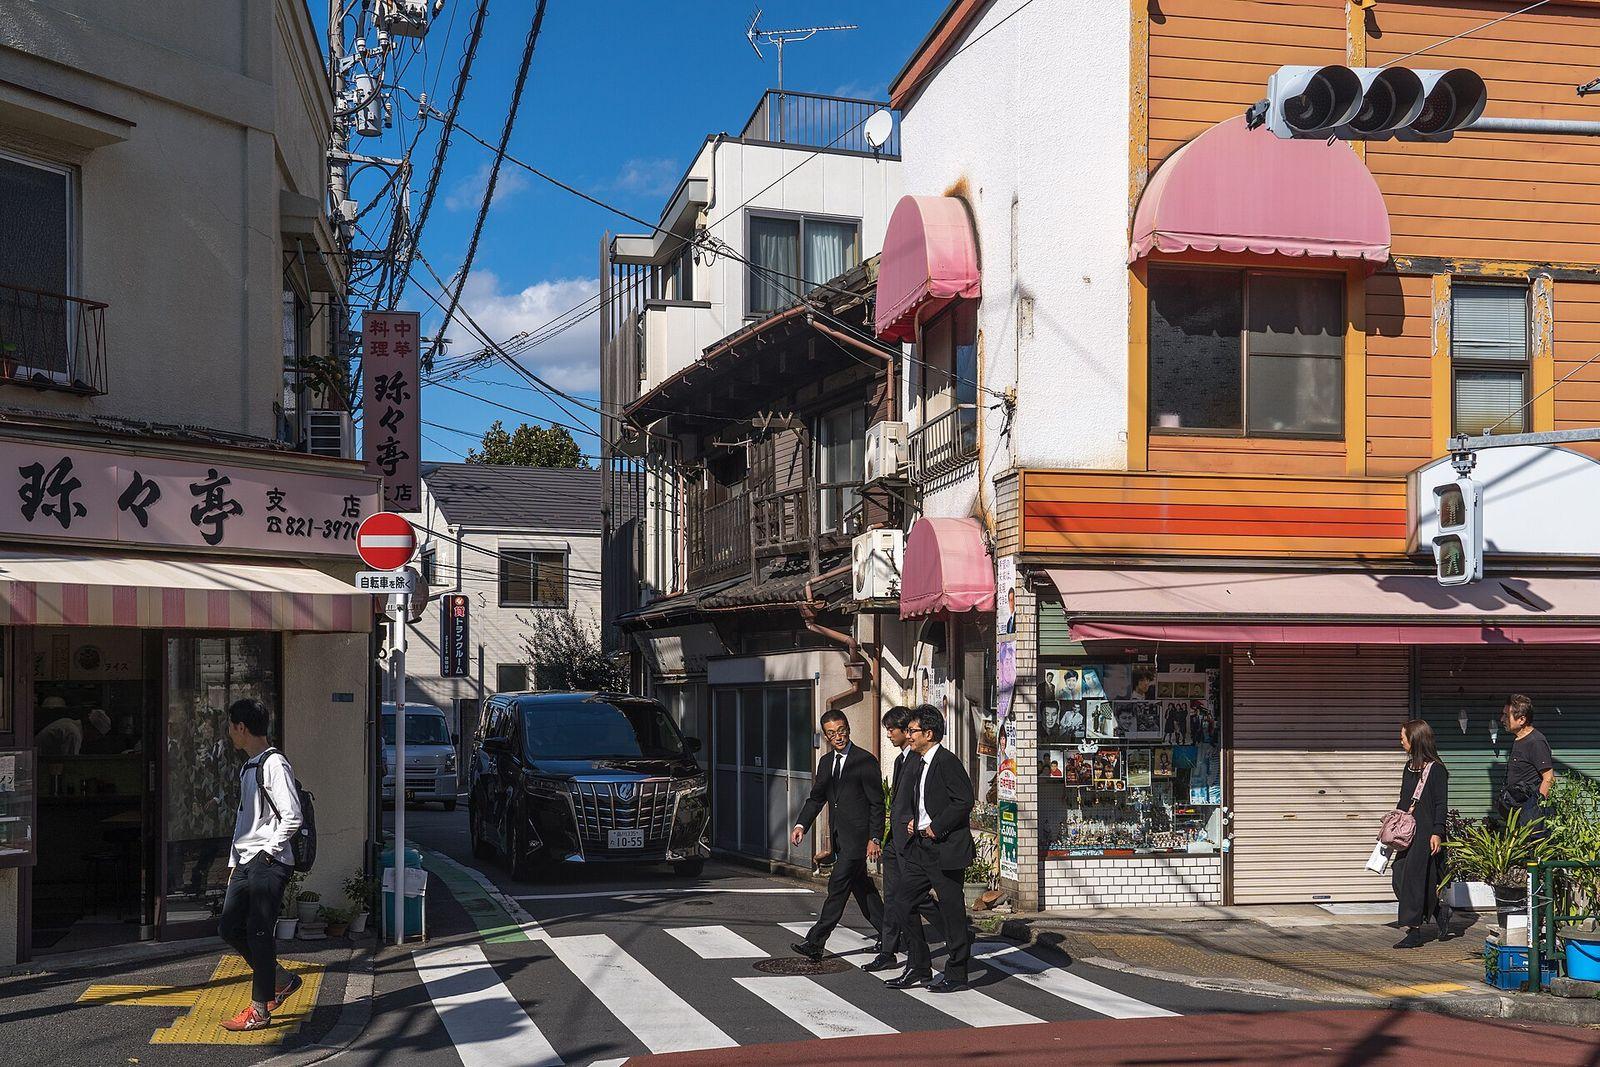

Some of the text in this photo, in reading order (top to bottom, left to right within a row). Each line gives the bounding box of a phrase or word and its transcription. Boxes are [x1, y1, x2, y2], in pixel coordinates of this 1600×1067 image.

[369, 320, 390, 357] 料理
[394, 320, 412, 358] 中華
[360, 576, 411, 589] 自転車を除く
[617, 837, 643, 847] 10-55
